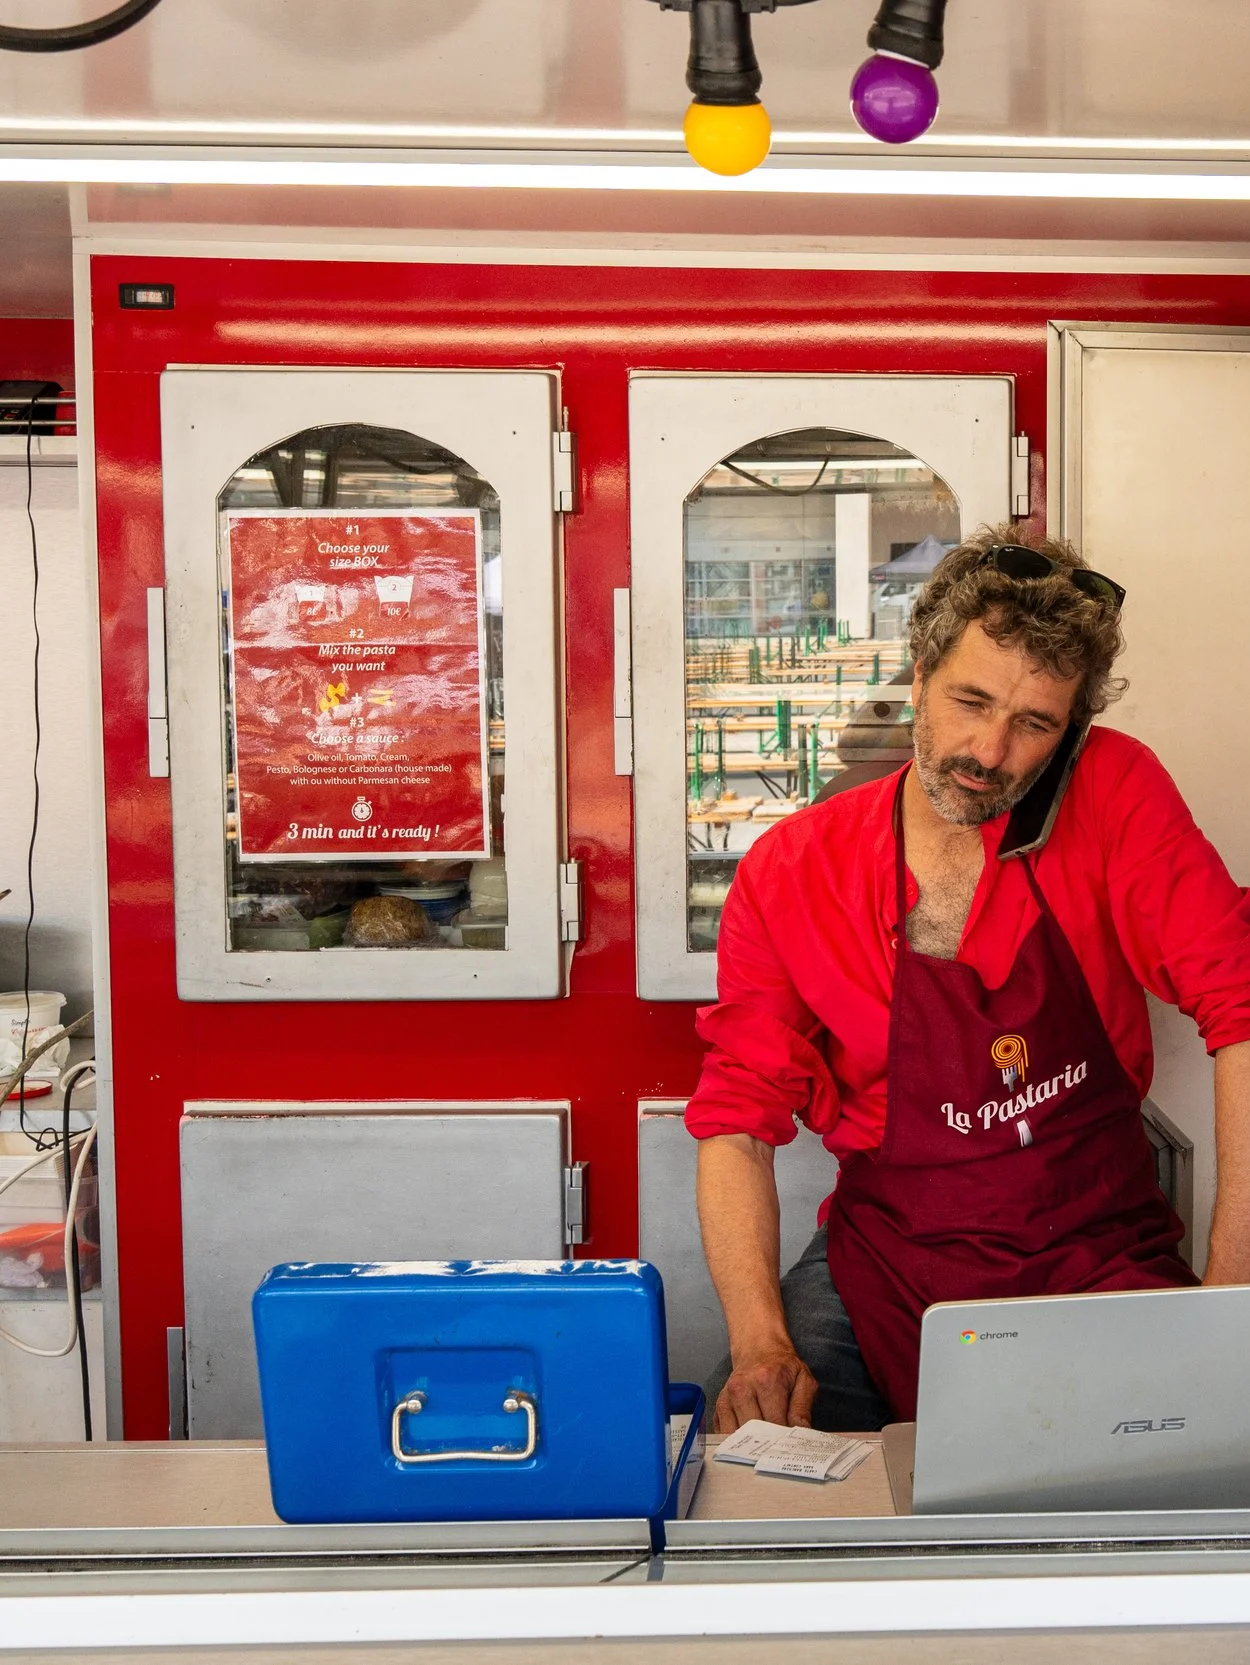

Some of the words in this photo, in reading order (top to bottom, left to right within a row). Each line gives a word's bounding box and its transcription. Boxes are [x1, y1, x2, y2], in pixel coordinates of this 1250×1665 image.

[345, 525, 360, 536] #1
[318, 542, 360, 554] Choose
[362, 544, 391, 556] your
[329, 555, 351, 567] size
[353, 556, 379, 567] BOX
[392, 584, 397, 592] 2
[349, 628, 364, 639] #2
[318, 644, 340, 655] Mix
[342, 645, 361, 655] the
[363, 646, 396, 657] pasta
[332, 662, 353, 674] you
[356, 661, 386, 671] want
[349, 717, 364, 728] #3
[311, 732, 354, 744] Choose
[356, 735, 364, 743] a
[366, 734, 399, 744] sauce
[307, 753, 330, 762] Olive
[331, 753, 343, 763] oil,
[344, 753, 378, 763] Tomato,
[380, 753, 410, 763] Cream,
[266, 765, 292, 774] Pesto,
[293, 765, 337, 775] Bolognese
[338, 766, 348, 774] or
[349, 765, 393, 774] Carbonara
[394, 764, 424, 774] (house
[425, 764, 452, 774] made)
[290, 776, 309, 785] with
[324, 776, 356, 785] without
[358, 776, 399, 785] Parmesan
[401, 776, 430, 785] cheese
[287, 823, 299, 840] 3
[302, 823, 334, 839] min
[338, 826, 364, 839] and
[392, 825, 431, 842] ready
[434, 825, 440, 838] !
[940, 1102, 972, 1135] La
[976, 1061, 1088, 1130] Pastaria
[979, 1329, 1019, 1342] chrome
[1110, 1417, 1187, 1435] ASUS
